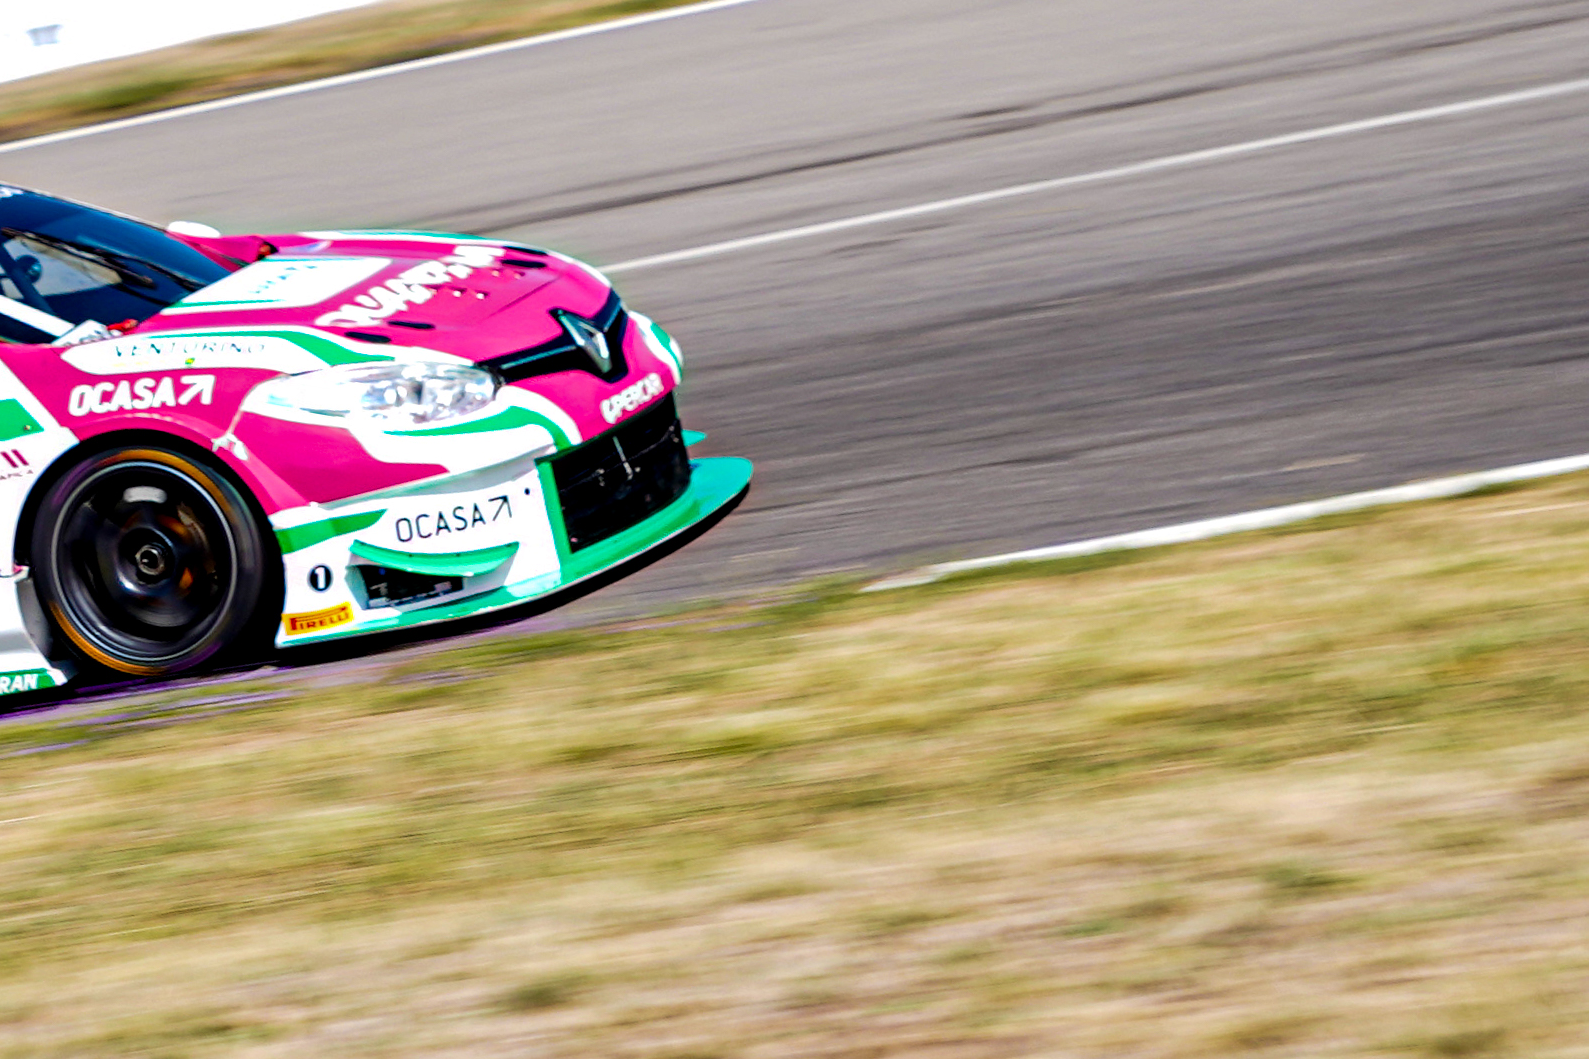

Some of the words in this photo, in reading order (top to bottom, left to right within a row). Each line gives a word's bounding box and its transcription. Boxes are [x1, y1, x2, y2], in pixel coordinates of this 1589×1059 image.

[115, 341, 267, 357] VENTURINO
[68, 376, 176, 417] OCASA
[395, 502, 487, 543] OCASA
[313, 566, 329, 591] 1
[289, 606, 350, 631] PIRELLI
